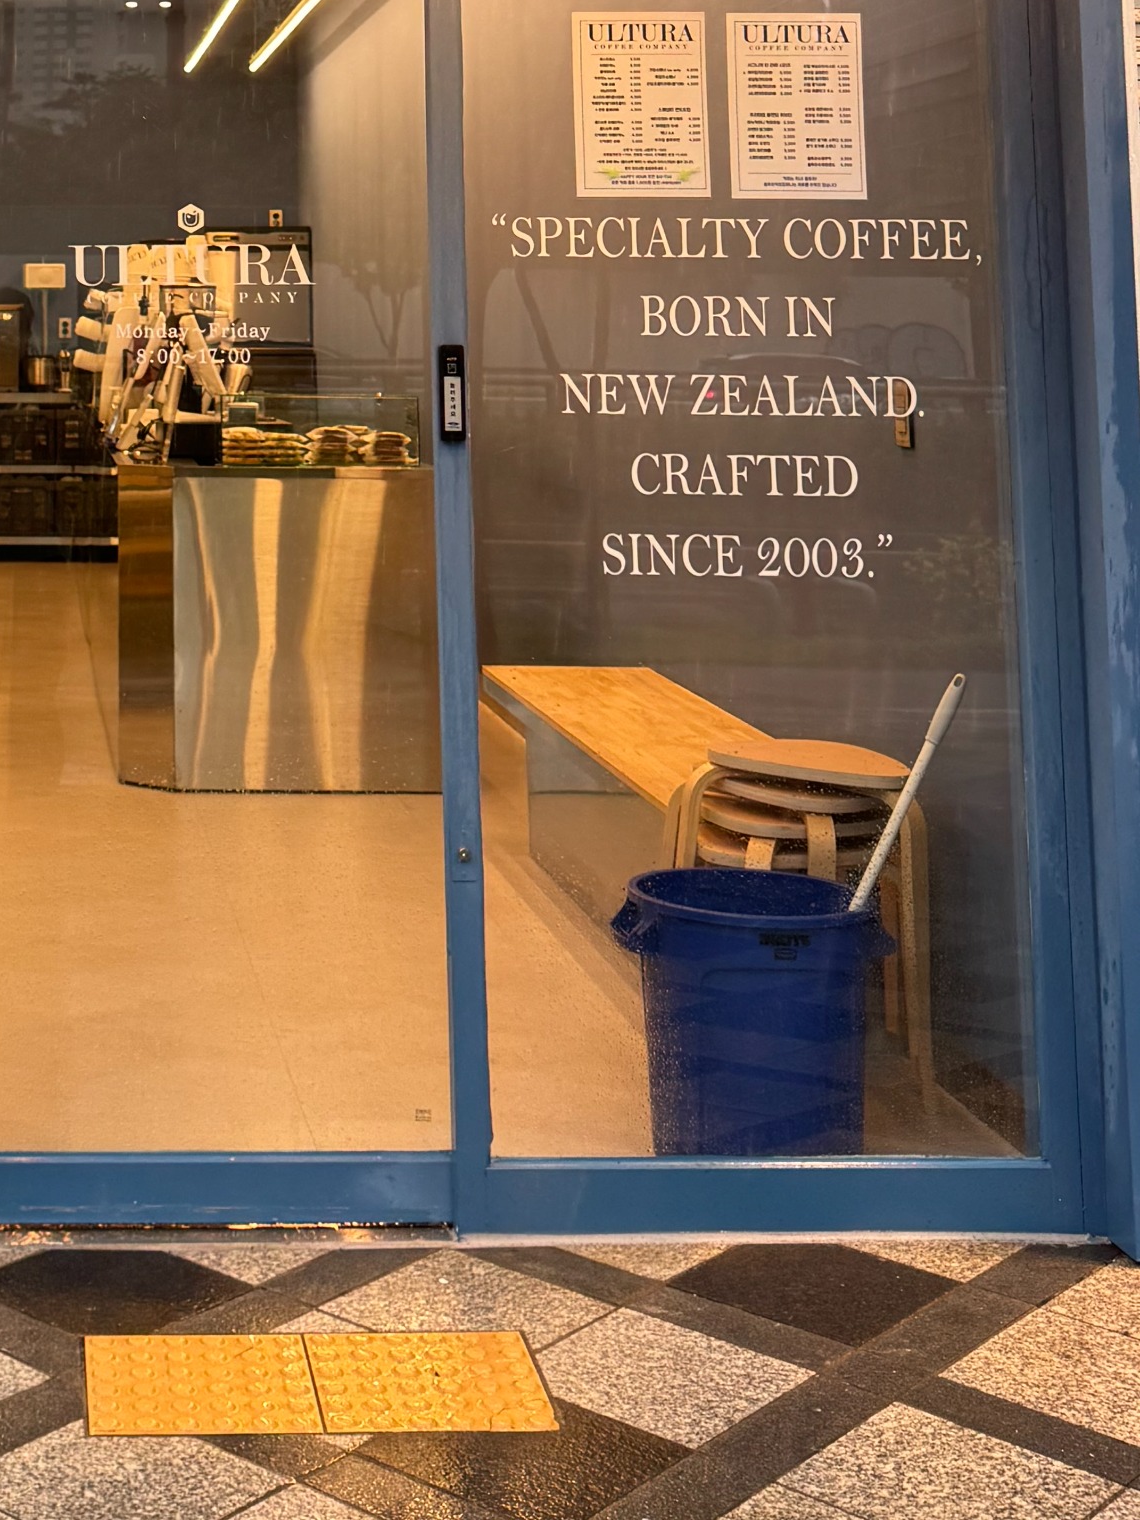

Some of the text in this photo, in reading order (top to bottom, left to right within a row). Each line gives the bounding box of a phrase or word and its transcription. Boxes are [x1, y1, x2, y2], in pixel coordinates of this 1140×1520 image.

[587, 23, 695, 42] ULTURA
[741, 24, 851, 44] ULTURA
[491, 212, 983, 266] “SPECIALTY COFFEE,
[68, 243, 317, 287] ULTURA
[188, 291, 298, 305] COPANY
[639, 295, 837, 338] BORN IN
[559, 373, 926, 418] NEW ZEALAND.
[631, 452, 859, 498] CRAFTED
[602, 532, 894, 580] SINCE 2003.”
